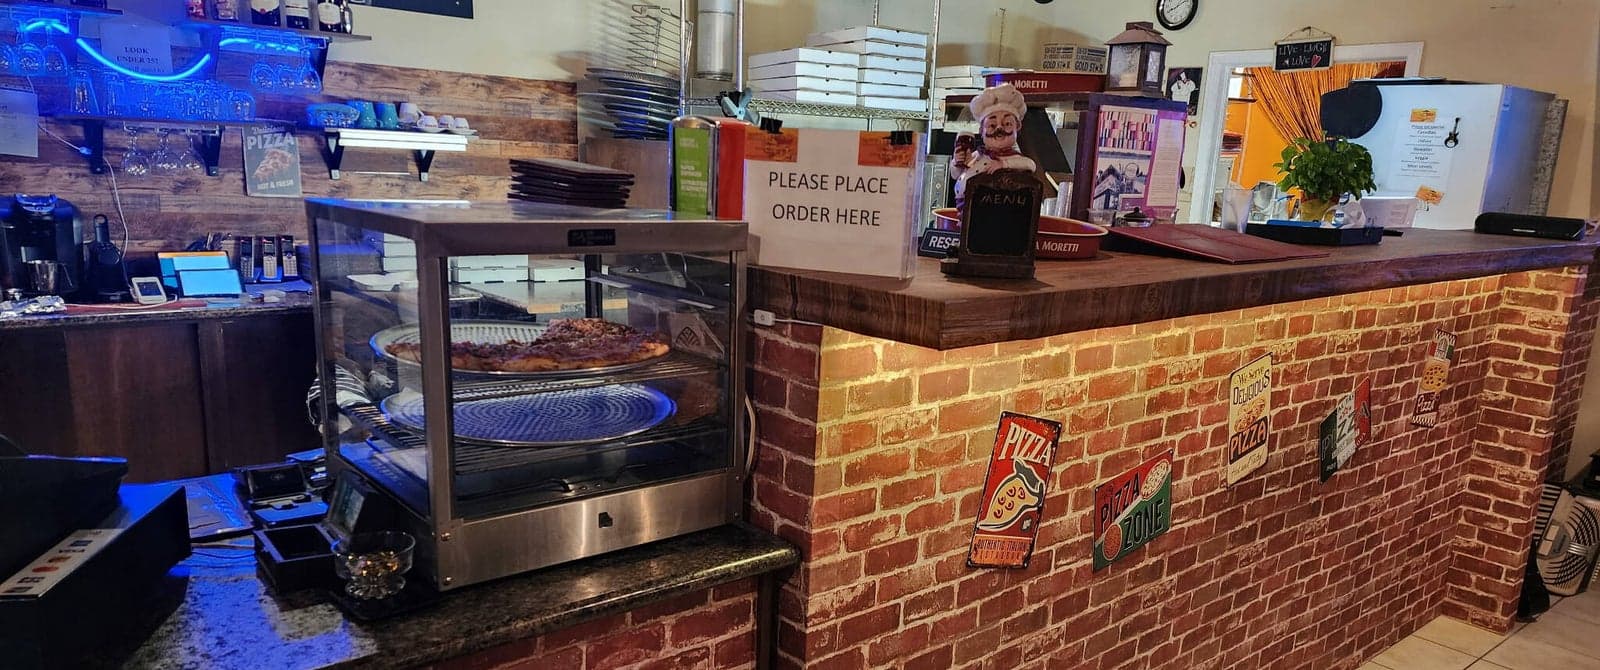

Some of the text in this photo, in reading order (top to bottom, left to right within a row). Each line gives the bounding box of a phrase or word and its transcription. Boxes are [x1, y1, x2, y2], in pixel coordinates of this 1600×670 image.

[1014, 79, 1048, 89] MORETTI
[246, 131, 295, 150] PIZZA
[768, 171, 889, 194] PLEASE PLACE
[982, 193, 1026, 206] MENU
[772, 203, 881, 227] ORDER HERE
[1042, 241, 1080, 252] MORETTI
[1233, 369, 1270, 405] DELICIOUS
[998, 422, 1052, 467] PIZZA
[1231, 421, 1266, 460] PIZZA
[1102, 471, 1140, 533] PIZZA
[1123, 498, 1166, 551] ZONE
